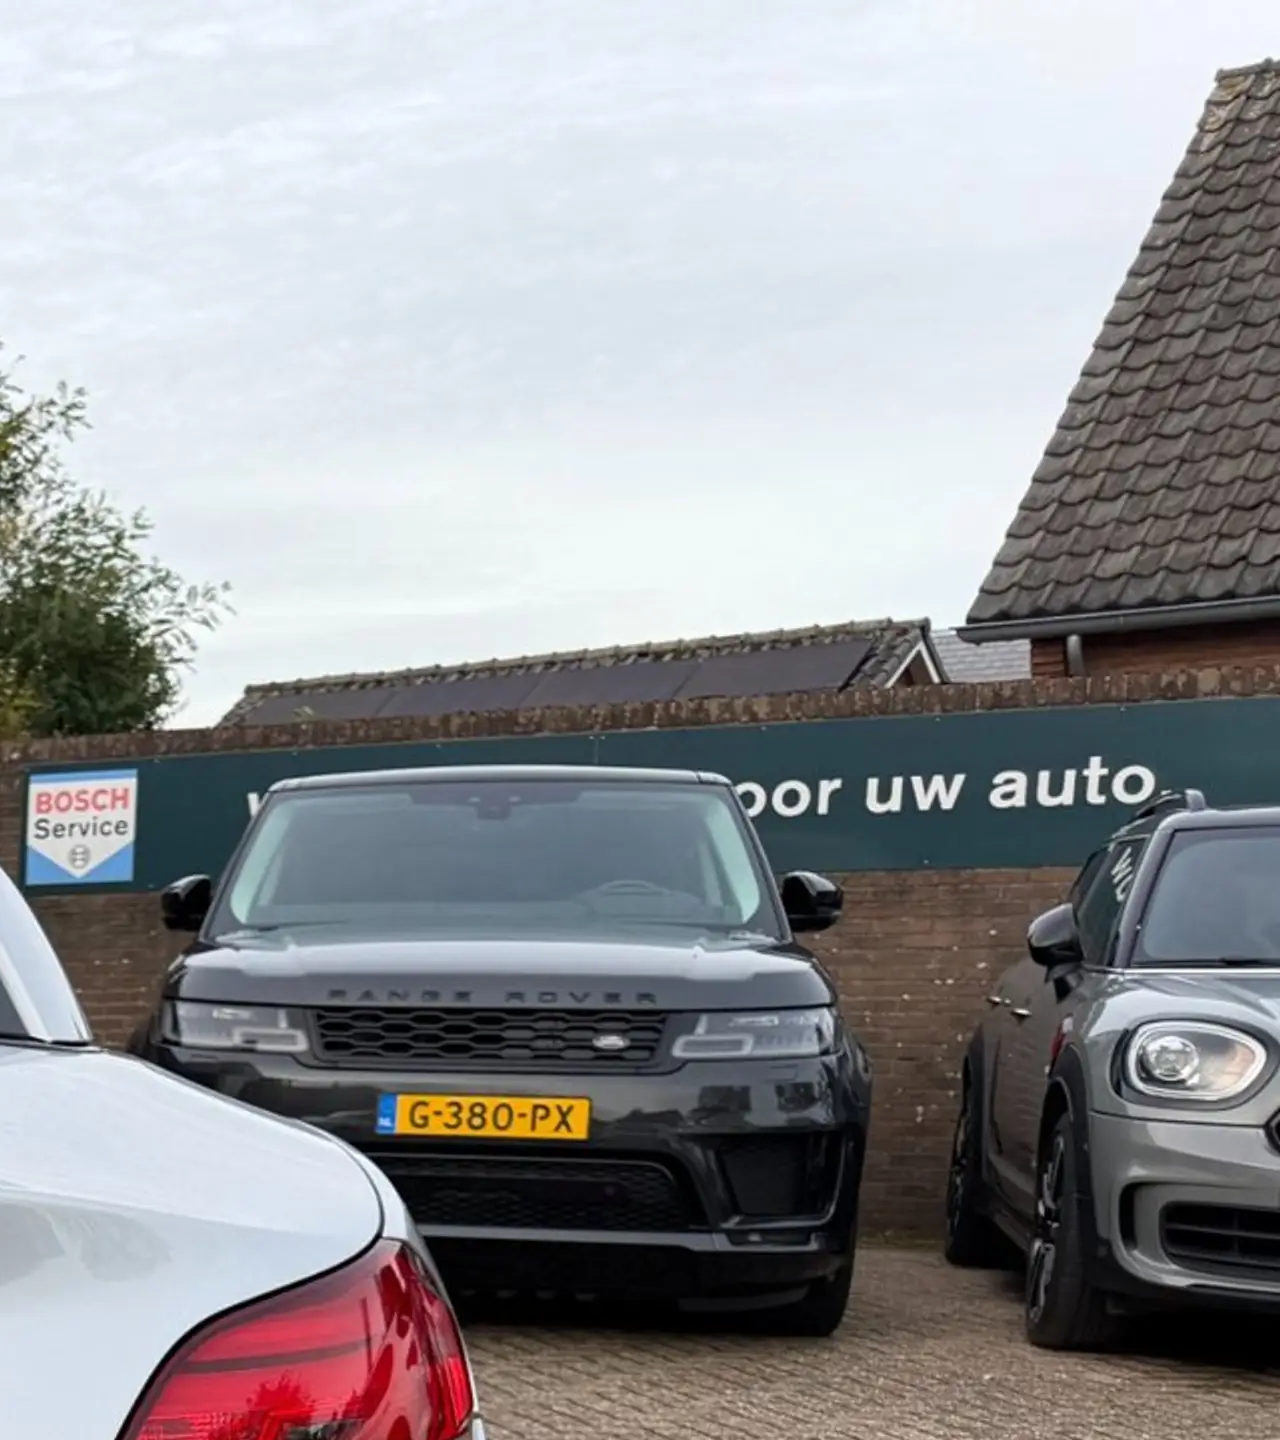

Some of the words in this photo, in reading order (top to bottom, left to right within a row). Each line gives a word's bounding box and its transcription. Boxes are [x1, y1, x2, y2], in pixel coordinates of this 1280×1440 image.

[35, 788, 131, 815] BOSCH
[735, 777, 843, 818] oor
[865, 772, 966, 814] uw
[34, 815, 129, 840] Service
[327, 988, 474, 1001] RANGE
[504, 990, 658, 1004] ROVER
[408, 1100, 575, 1133] G-380-PX
